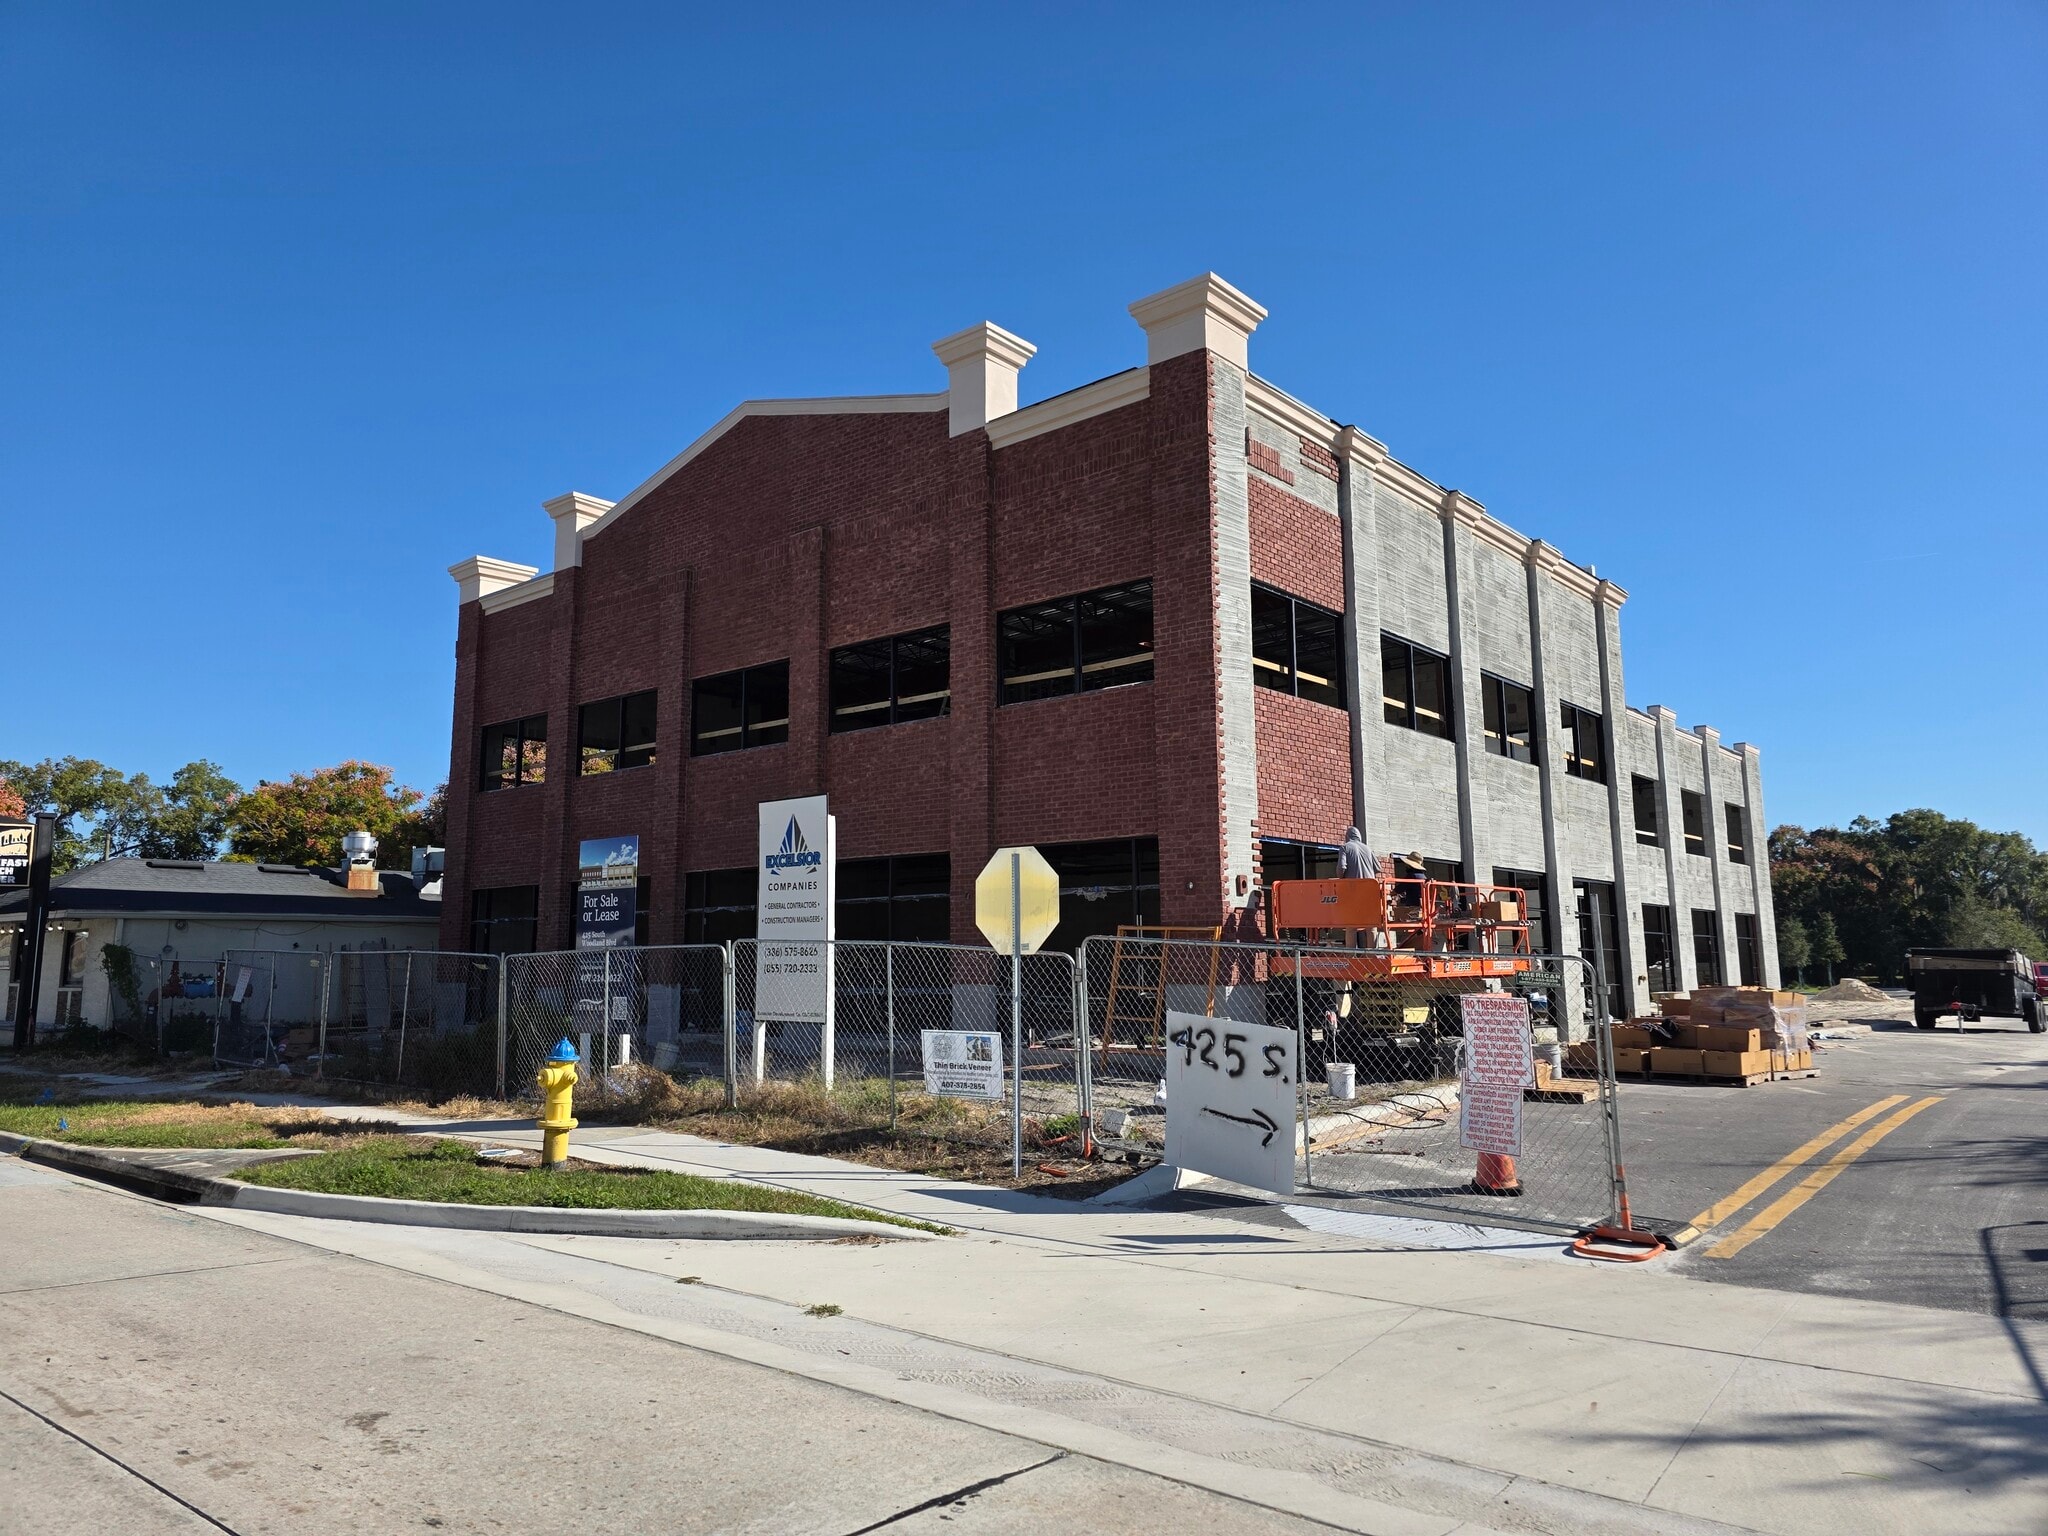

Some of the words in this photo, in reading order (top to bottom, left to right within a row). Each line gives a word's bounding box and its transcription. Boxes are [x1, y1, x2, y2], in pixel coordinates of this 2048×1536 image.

[766, 851, 821, 869] EXCELSIOR
[768, 881, 818, 891] COMPANIES
[583, 895, 598, 908] For
[600, 893, 619, 907] Sale
[767, 902, 786, 910] GENERAL
[787, 901, 817, 910] CONTRACTORS
[1320, 896, 1338, 904] JLG
[583, 911, 592, 922] or
[595, 909, 620, 922] Lease
[764, 916, 795, 925] CONSTRUCTION
[797, 915, 820, 923] MANAGERS
[764, 963, 782, 974] (855)
[1518, 971, 1561, 980] AMERICAN
[1465, 1000, 1474, 1009] NO
[1477, 1000, 1524, 1011] TRESPASSING
[1170, 1026, 1247, 1078] 425
